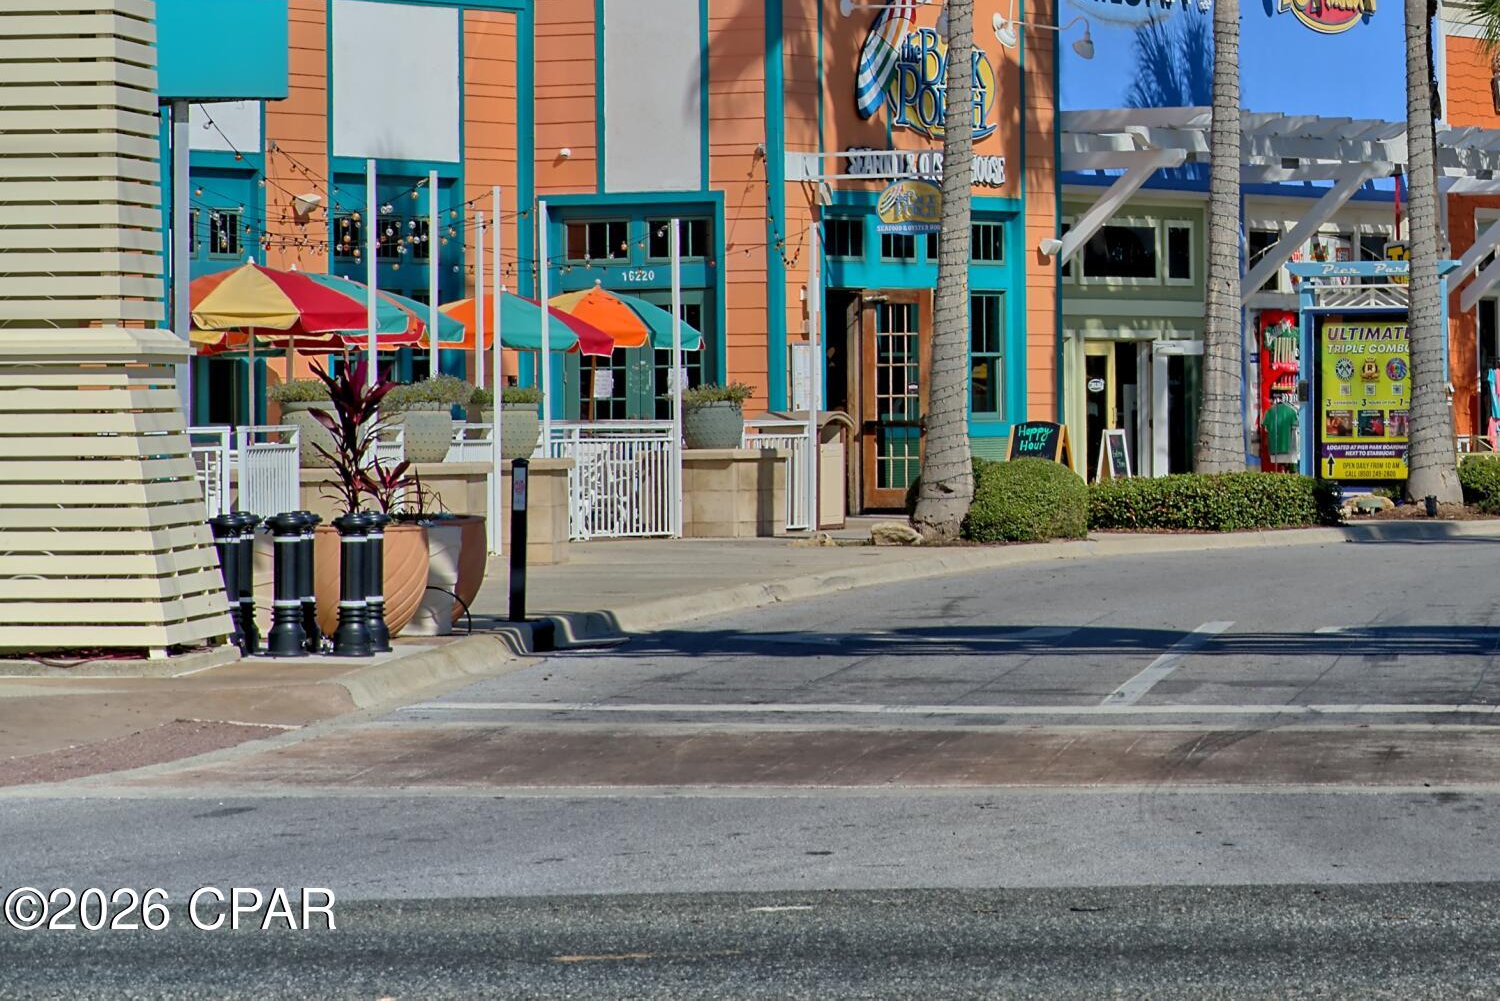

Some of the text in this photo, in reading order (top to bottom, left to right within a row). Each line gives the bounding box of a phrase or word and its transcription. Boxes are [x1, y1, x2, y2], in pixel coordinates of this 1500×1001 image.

[901, 33, 921, 62] the
[919, 28, 986, 89] BK
[895, 63, 986, 129] POH
[1321, 263, 1361, 274] Pier
[622, 270, 655, 281] 16220
[1328, 345, 1365, 354] TRIPLE
[1020, 440, 1046, 451] Hour
[1345, 470, 1357, 478] CALL
